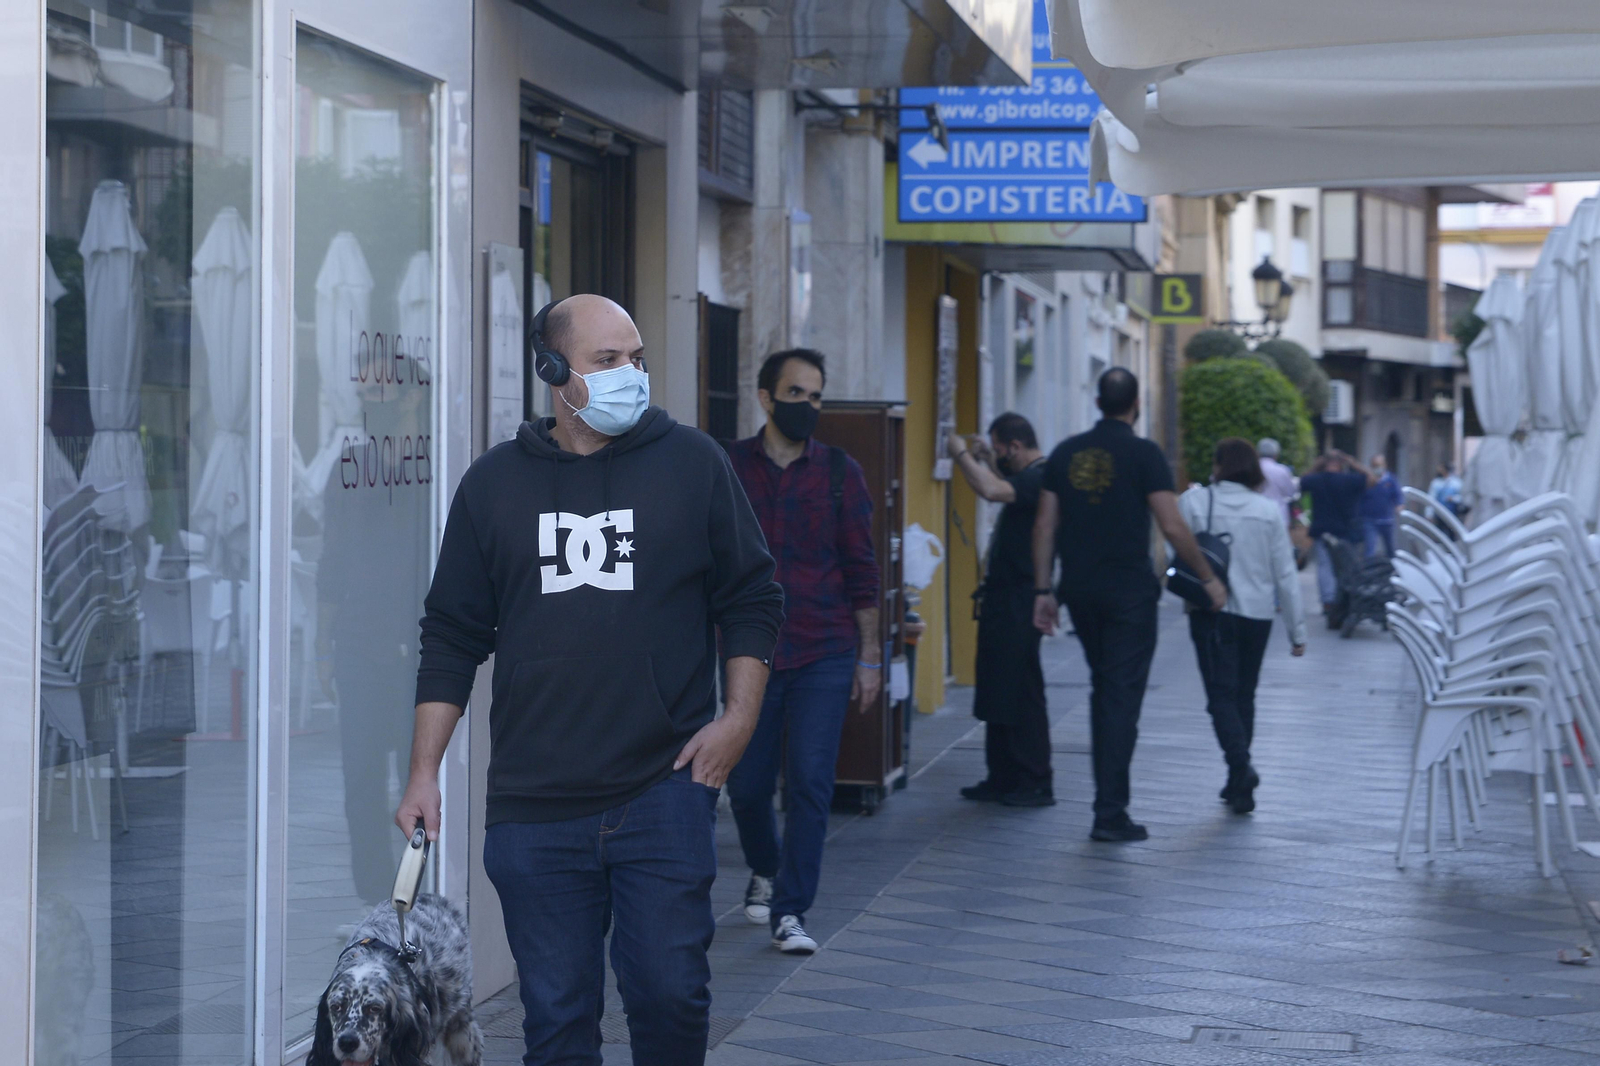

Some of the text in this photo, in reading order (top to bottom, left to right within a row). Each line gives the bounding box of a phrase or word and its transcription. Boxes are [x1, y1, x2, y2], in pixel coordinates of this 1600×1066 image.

[1049, 75, 1078, 96] 36
[940, 99, 1106, 124] ww.gibralcop.
[951, 140, 1089, 170] IMPREN
[908, 185, 1134, 215] COPISTERIA
[349, 309, 370, 384] Lo
[373, 330, 405, 404] que
[340, 434, 360, 490] es
[363, 411, 379, 489] lo
[381, 434, 413, 506] que
